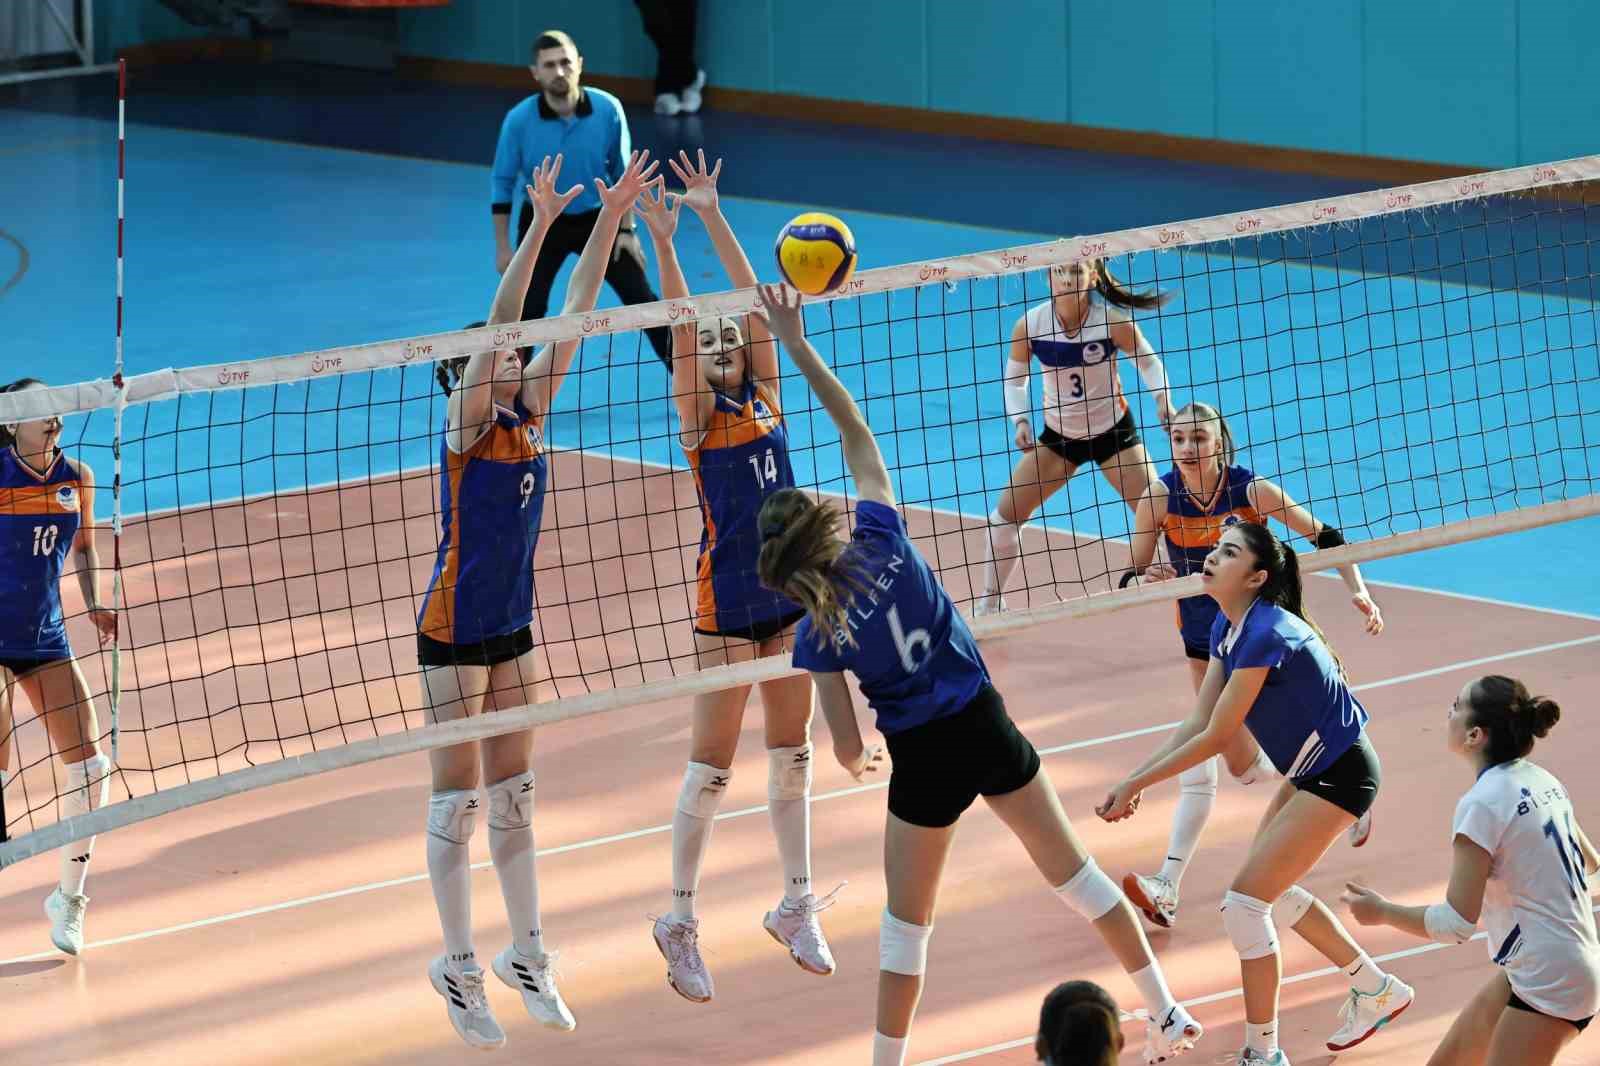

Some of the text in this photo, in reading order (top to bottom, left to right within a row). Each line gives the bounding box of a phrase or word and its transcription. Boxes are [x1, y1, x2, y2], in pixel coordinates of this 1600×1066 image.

[1397, 194, 1412, 203] TVF
[1322, 206, 1337, 215] TVF
[1247, 218, 1262, 228] TVF
[1092, 242, 1107, 252] TVF
[1011, 255, 1027, 264] TVF
[931, 268, 947, 277] TVF
[849, 280, 865, 289] TVF
[592, 318, 610, 328] TVF
[506, 331, 522, 341] TVF
[415, 345, 432, 356] TVF
[325, 358, 342, 369] TVF
[231, 371, 249, 381] TVF
[1069, 373, 1084, 398] 3
[749, 448, 777, 488] 14
[520, 472, 535, 509] 9
[33, 525, 58, 556] 10
[886, 603, 932, 674] 6
